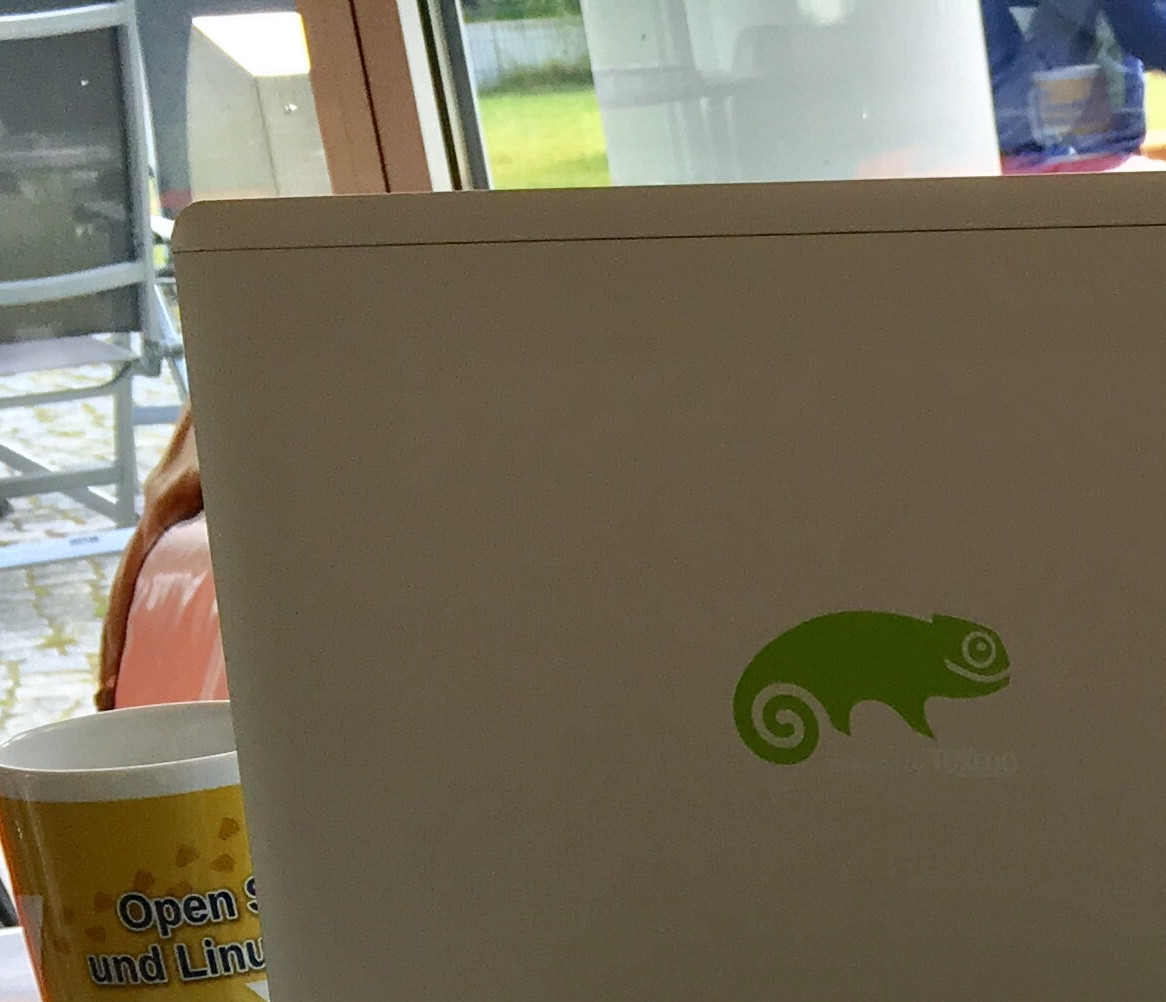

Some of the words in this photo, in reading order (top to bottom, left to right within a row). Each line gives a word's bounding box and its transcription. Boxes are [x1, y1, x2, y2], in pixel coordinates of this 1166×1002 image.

[116, 889, 238, 938] Open
[88, 943, 168, 985] und
[174, 937, 266, 980] Linu
